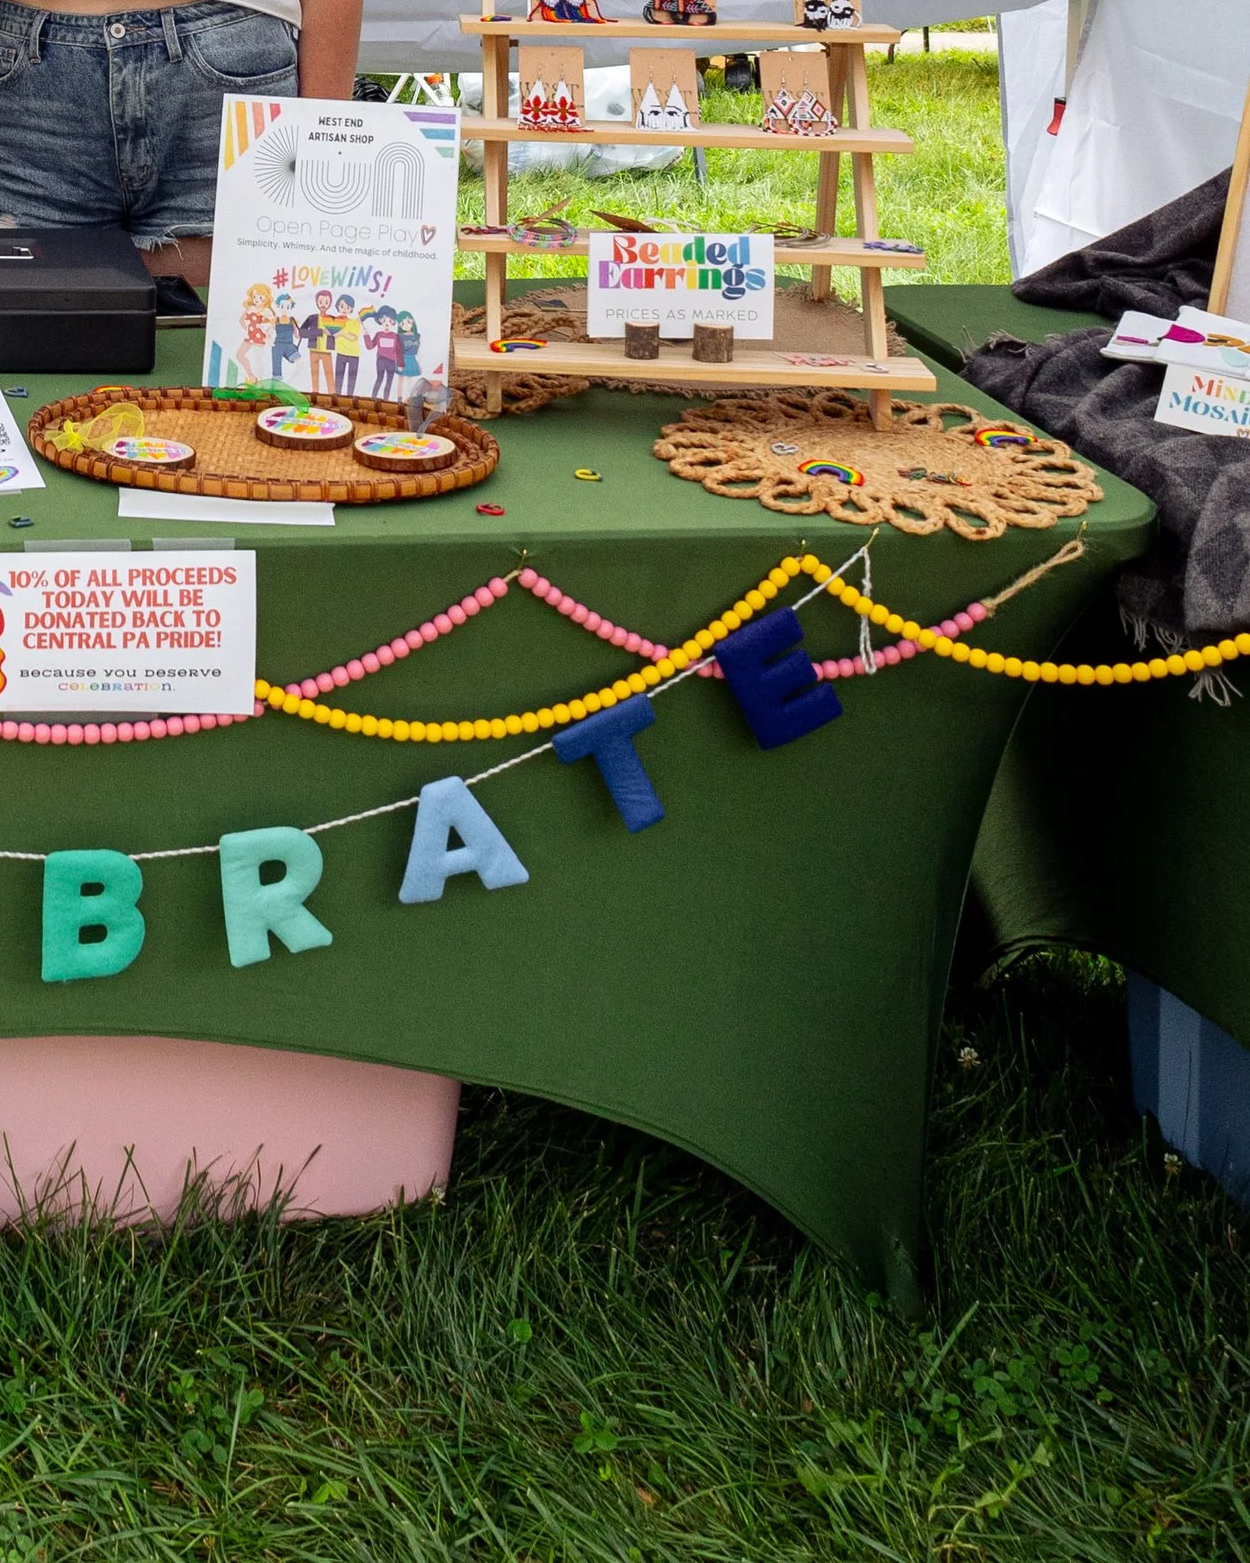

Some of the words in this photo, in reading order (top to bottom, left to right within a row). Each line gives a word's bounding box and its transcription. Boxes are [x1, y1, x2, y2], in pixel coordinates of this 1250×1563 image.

[318, 116, 342, 127] WEST
[345, 117, 363, 129] END
[308, 131, 348, 142] ARTISAN
[349, 133, 374, 144] SHOP
[256, 215, 312, 237] Open
[319, 220, 371, 243] Page
[378, 224, 419, 246] Play
[237, 238, 280, 250] Simplicity.
[283, 241, 317, 253] Whimsy.
[320, 244, 336, 253] And
[339, 245, 353, 254] the
[355, 248, 379, 257] magic
[382, 249, 391, 257] of
[393, 250, 438, 260] childhood.
[613, 235, 750, 265] Beaded
[599, 260, 766, 300] Earrings
[606, 308, 660, 320] PRICES
[666, 310, 686, 320] AS
[692, 310, 758, 321] MARKED
[9, 570, 48, 588] 10%
[54, 569, 81, 588] OF
[87, 569, 122, 587] ALL
[128, 566, 237, 586] PROCEEDS
[42, 590, 114, 608] TODAY
[121, 589, 173, 607] WILL
[179, 589, 203, 606] BE
[24, 611, 126, 629] DONATED
[132, 610, 186, 628] BACK
[192, 609, 221, 627] TO
[23, 632, 116, 649] CENTRAL
[122, 631, 150, 649] PA
[156, 630, 222, 648] PRIDE!
[104, 669, 137, 677] you
